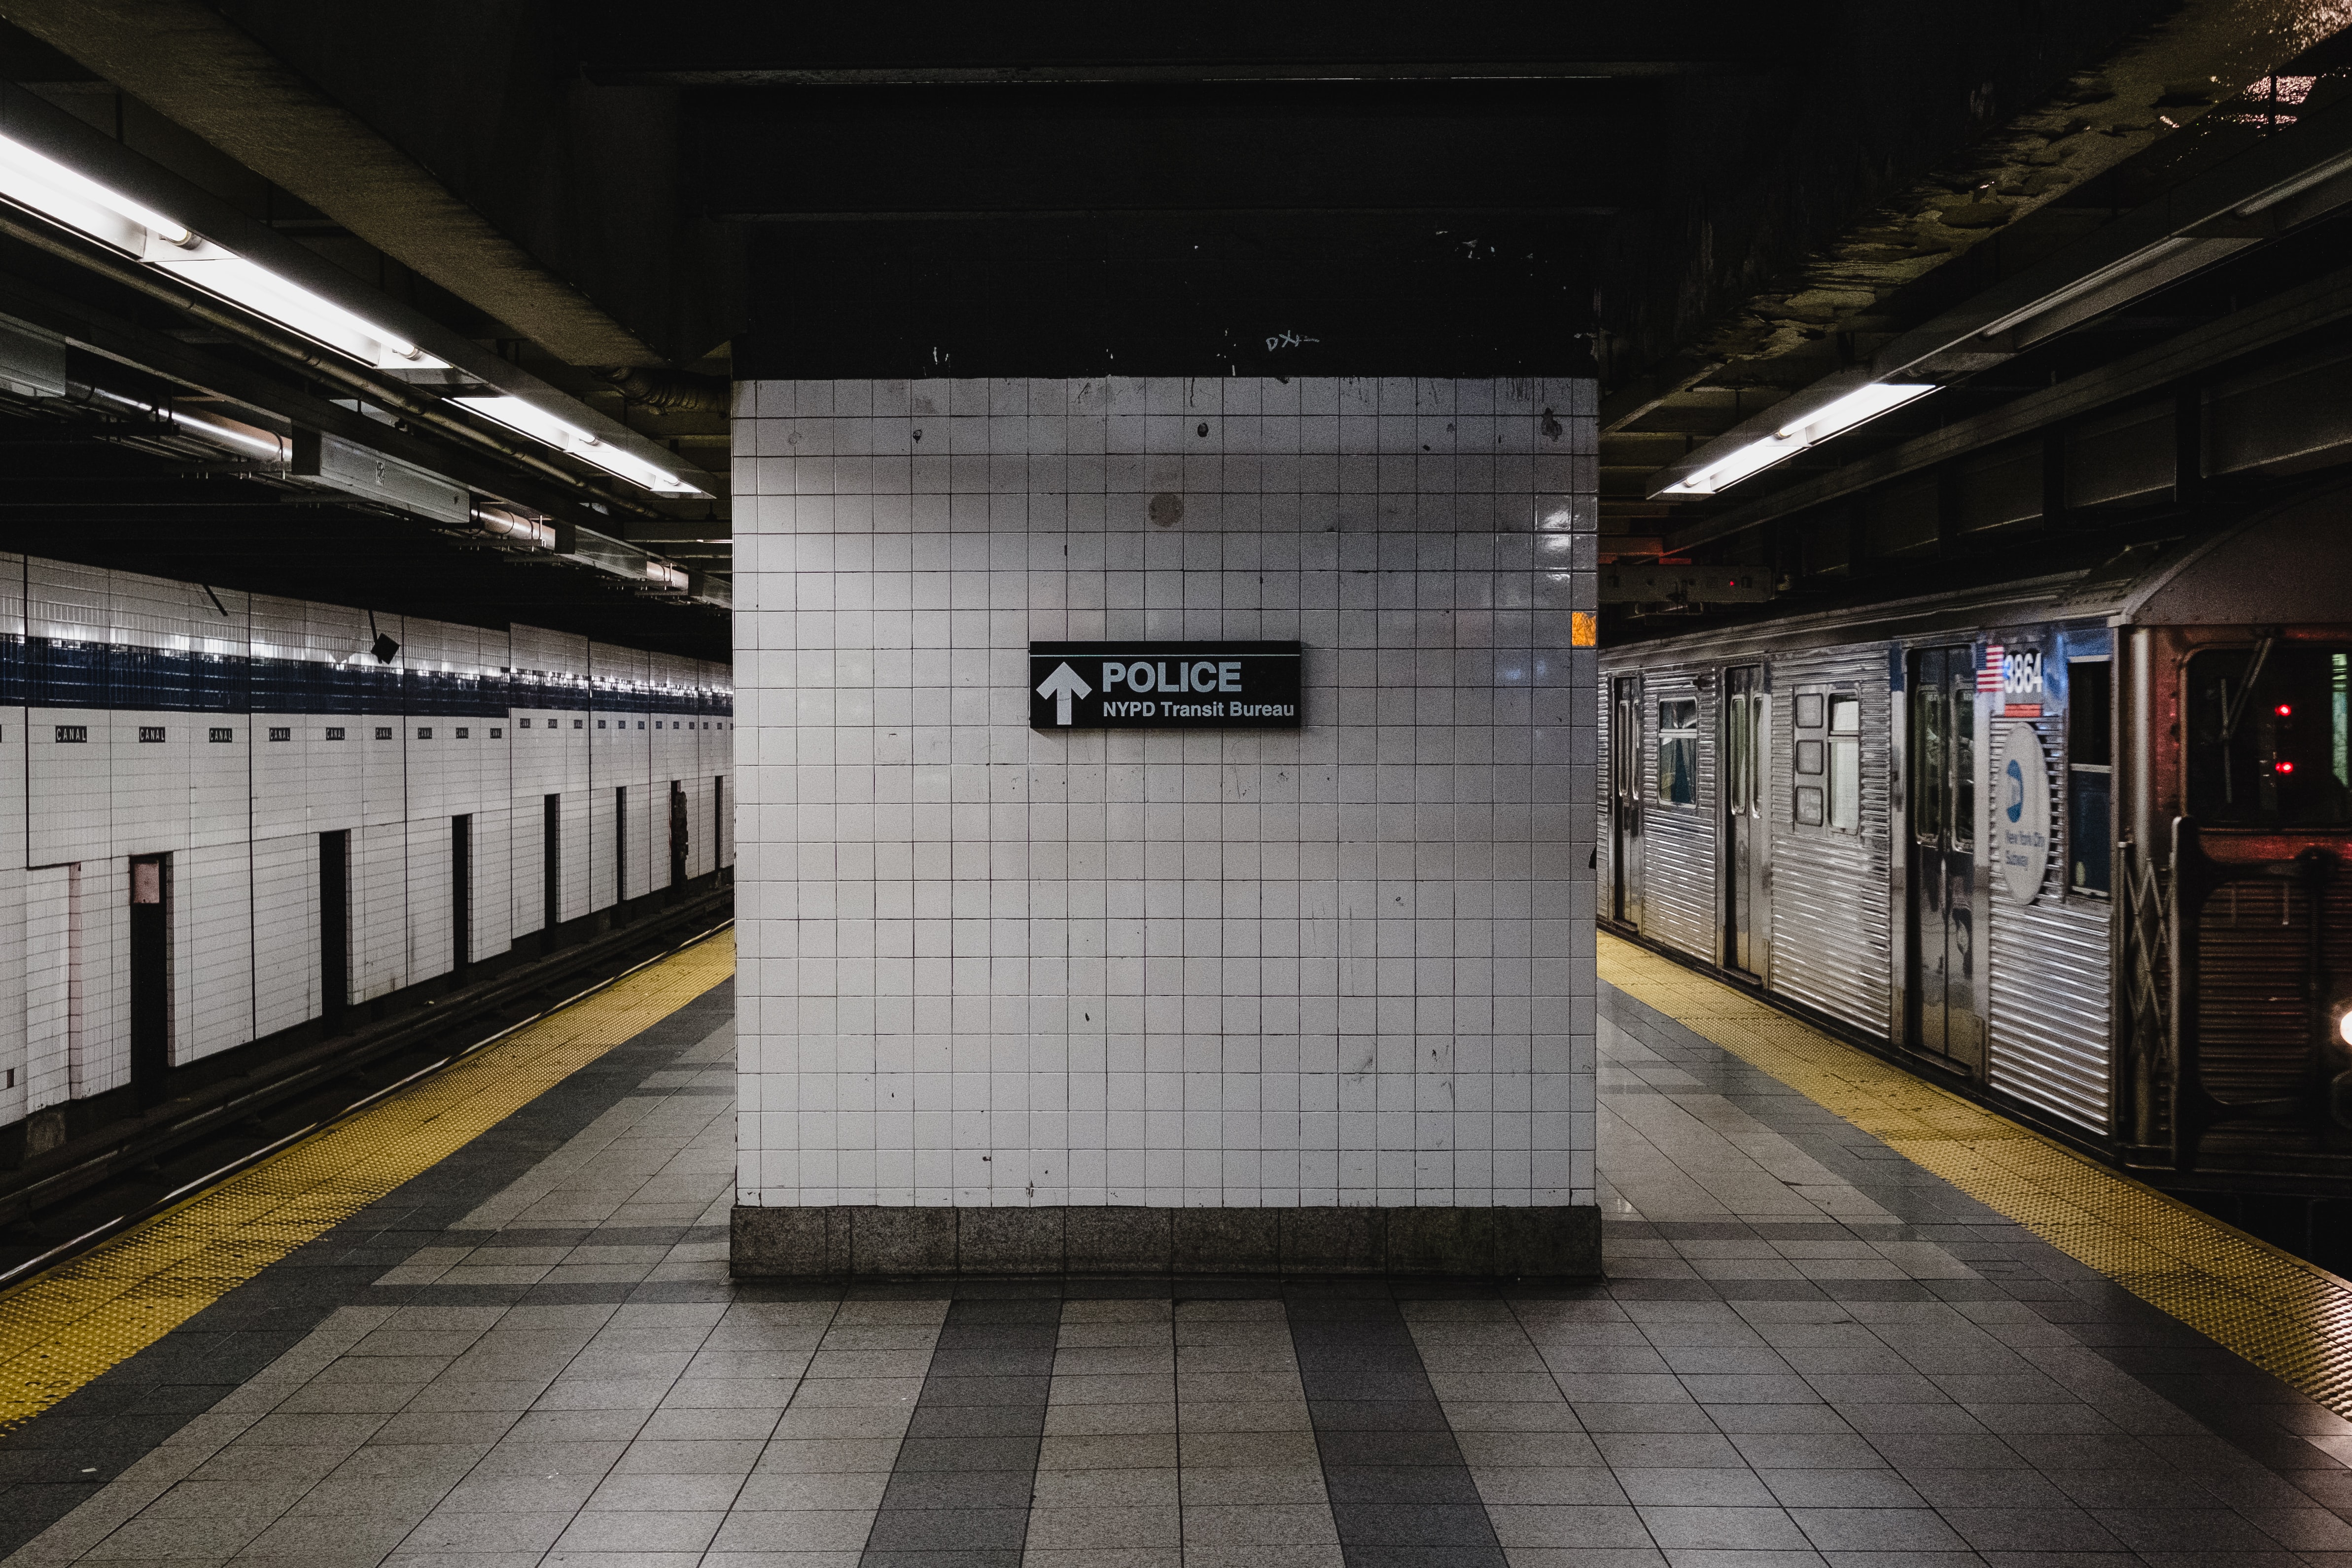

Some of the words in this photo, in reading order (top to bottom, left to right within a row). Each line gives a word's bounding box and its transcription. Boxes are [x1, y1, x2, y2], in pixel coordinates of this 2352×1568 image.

[1102, 661, 1242, 693] POLICE
[2003, 653, 2042, 693] 3864
[1103, 701, 1156, 717] NYPD
[1160, 701, 1224, 717] Transit
[1229, 701, 1294, 717] Bureau
[57, 728, 86, 741] CANAL
[140, 729, 164, 740] CANAL
[210, 730, 232, 740] CANAL
[270, 729, 289, 739] CANAL
[326, 729, 344, 738] CANAL
[376, 729, 392, 737] CANAL
